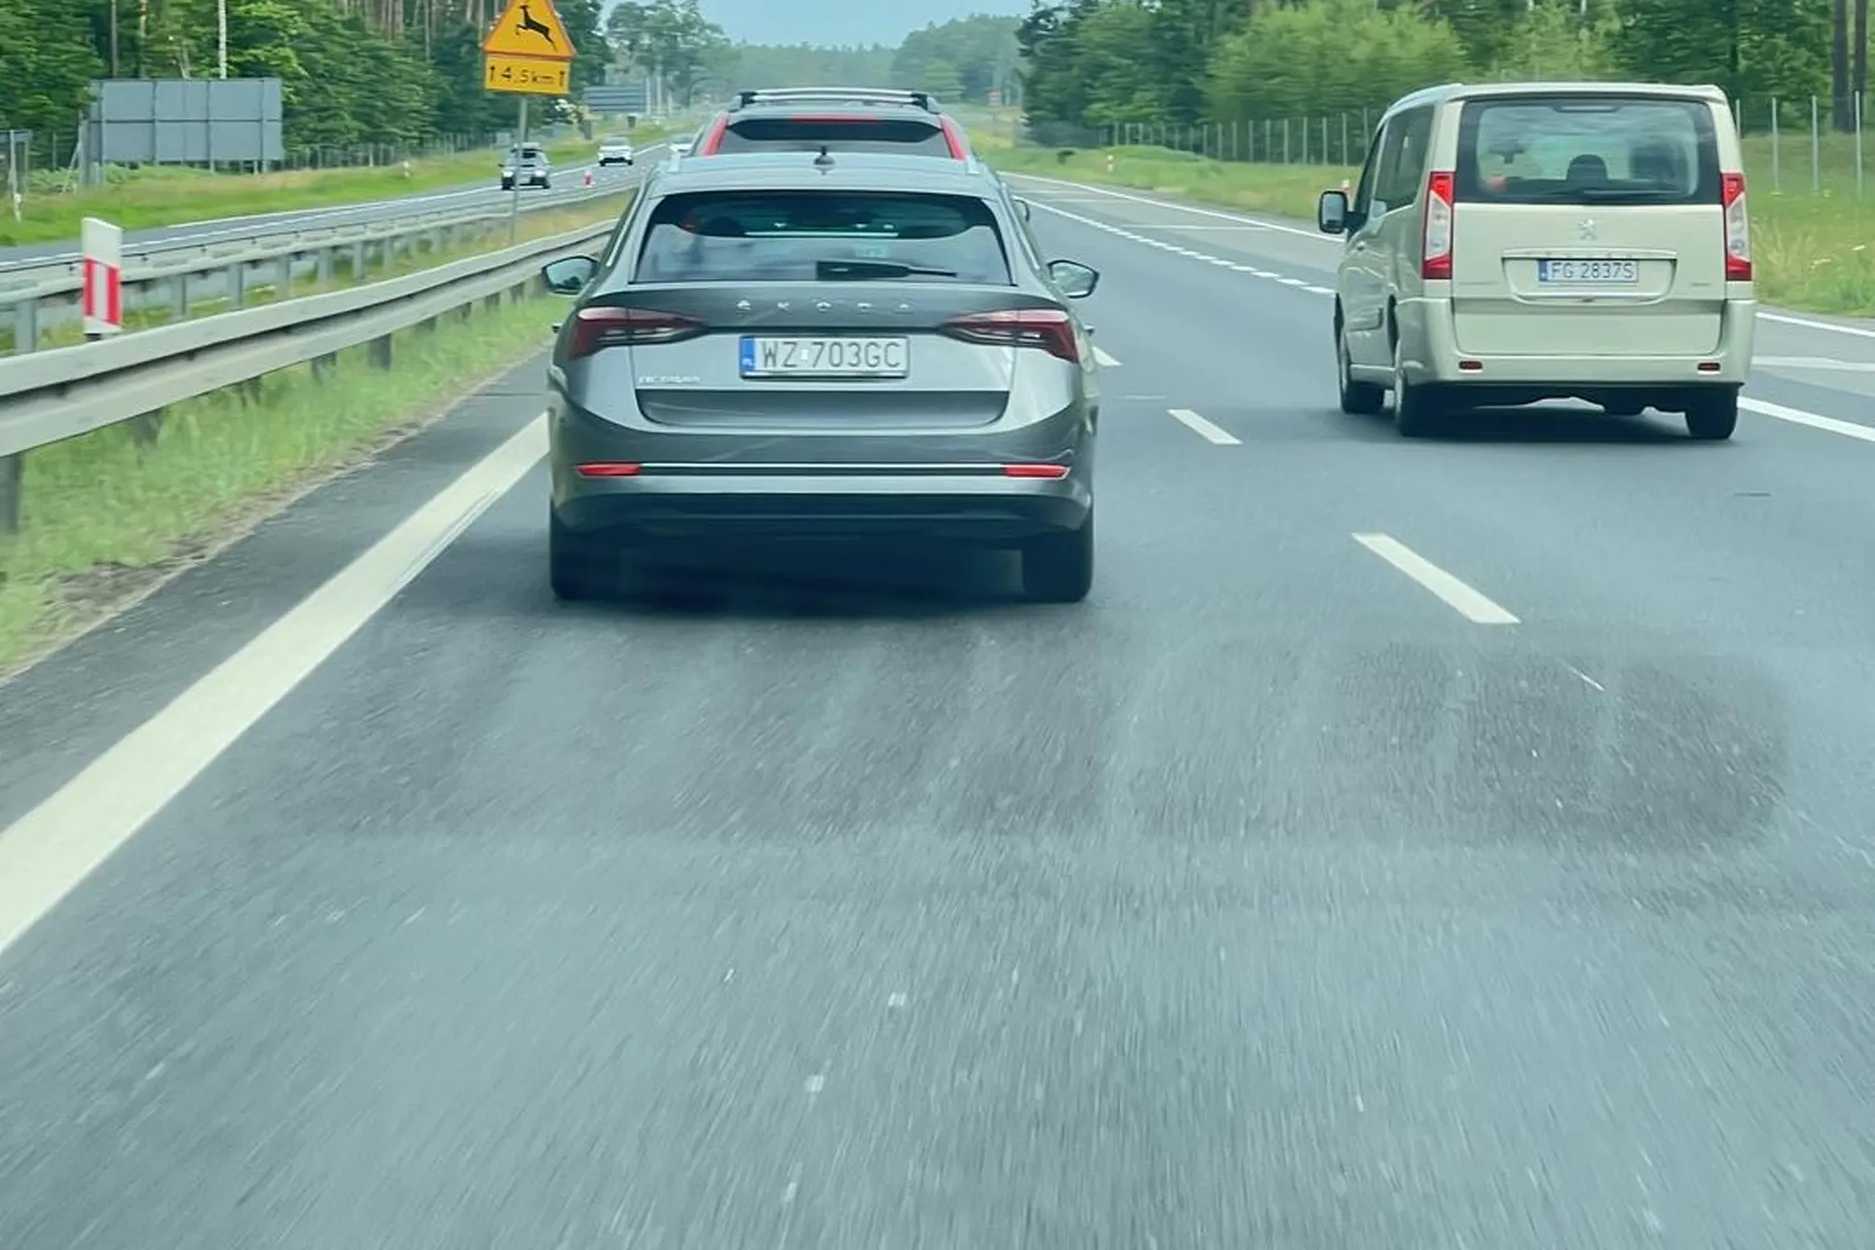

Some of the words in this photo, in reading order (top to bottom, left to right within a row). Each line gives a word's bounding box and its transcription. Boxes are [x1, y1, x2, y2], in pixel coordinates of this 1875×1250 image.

[1551, 261, 1574, 279] FG
[1580, 261, 1635, 279] 2837S
[763, 341, 798, 368] WZ
[812, 342, 901, 368] 703GC
